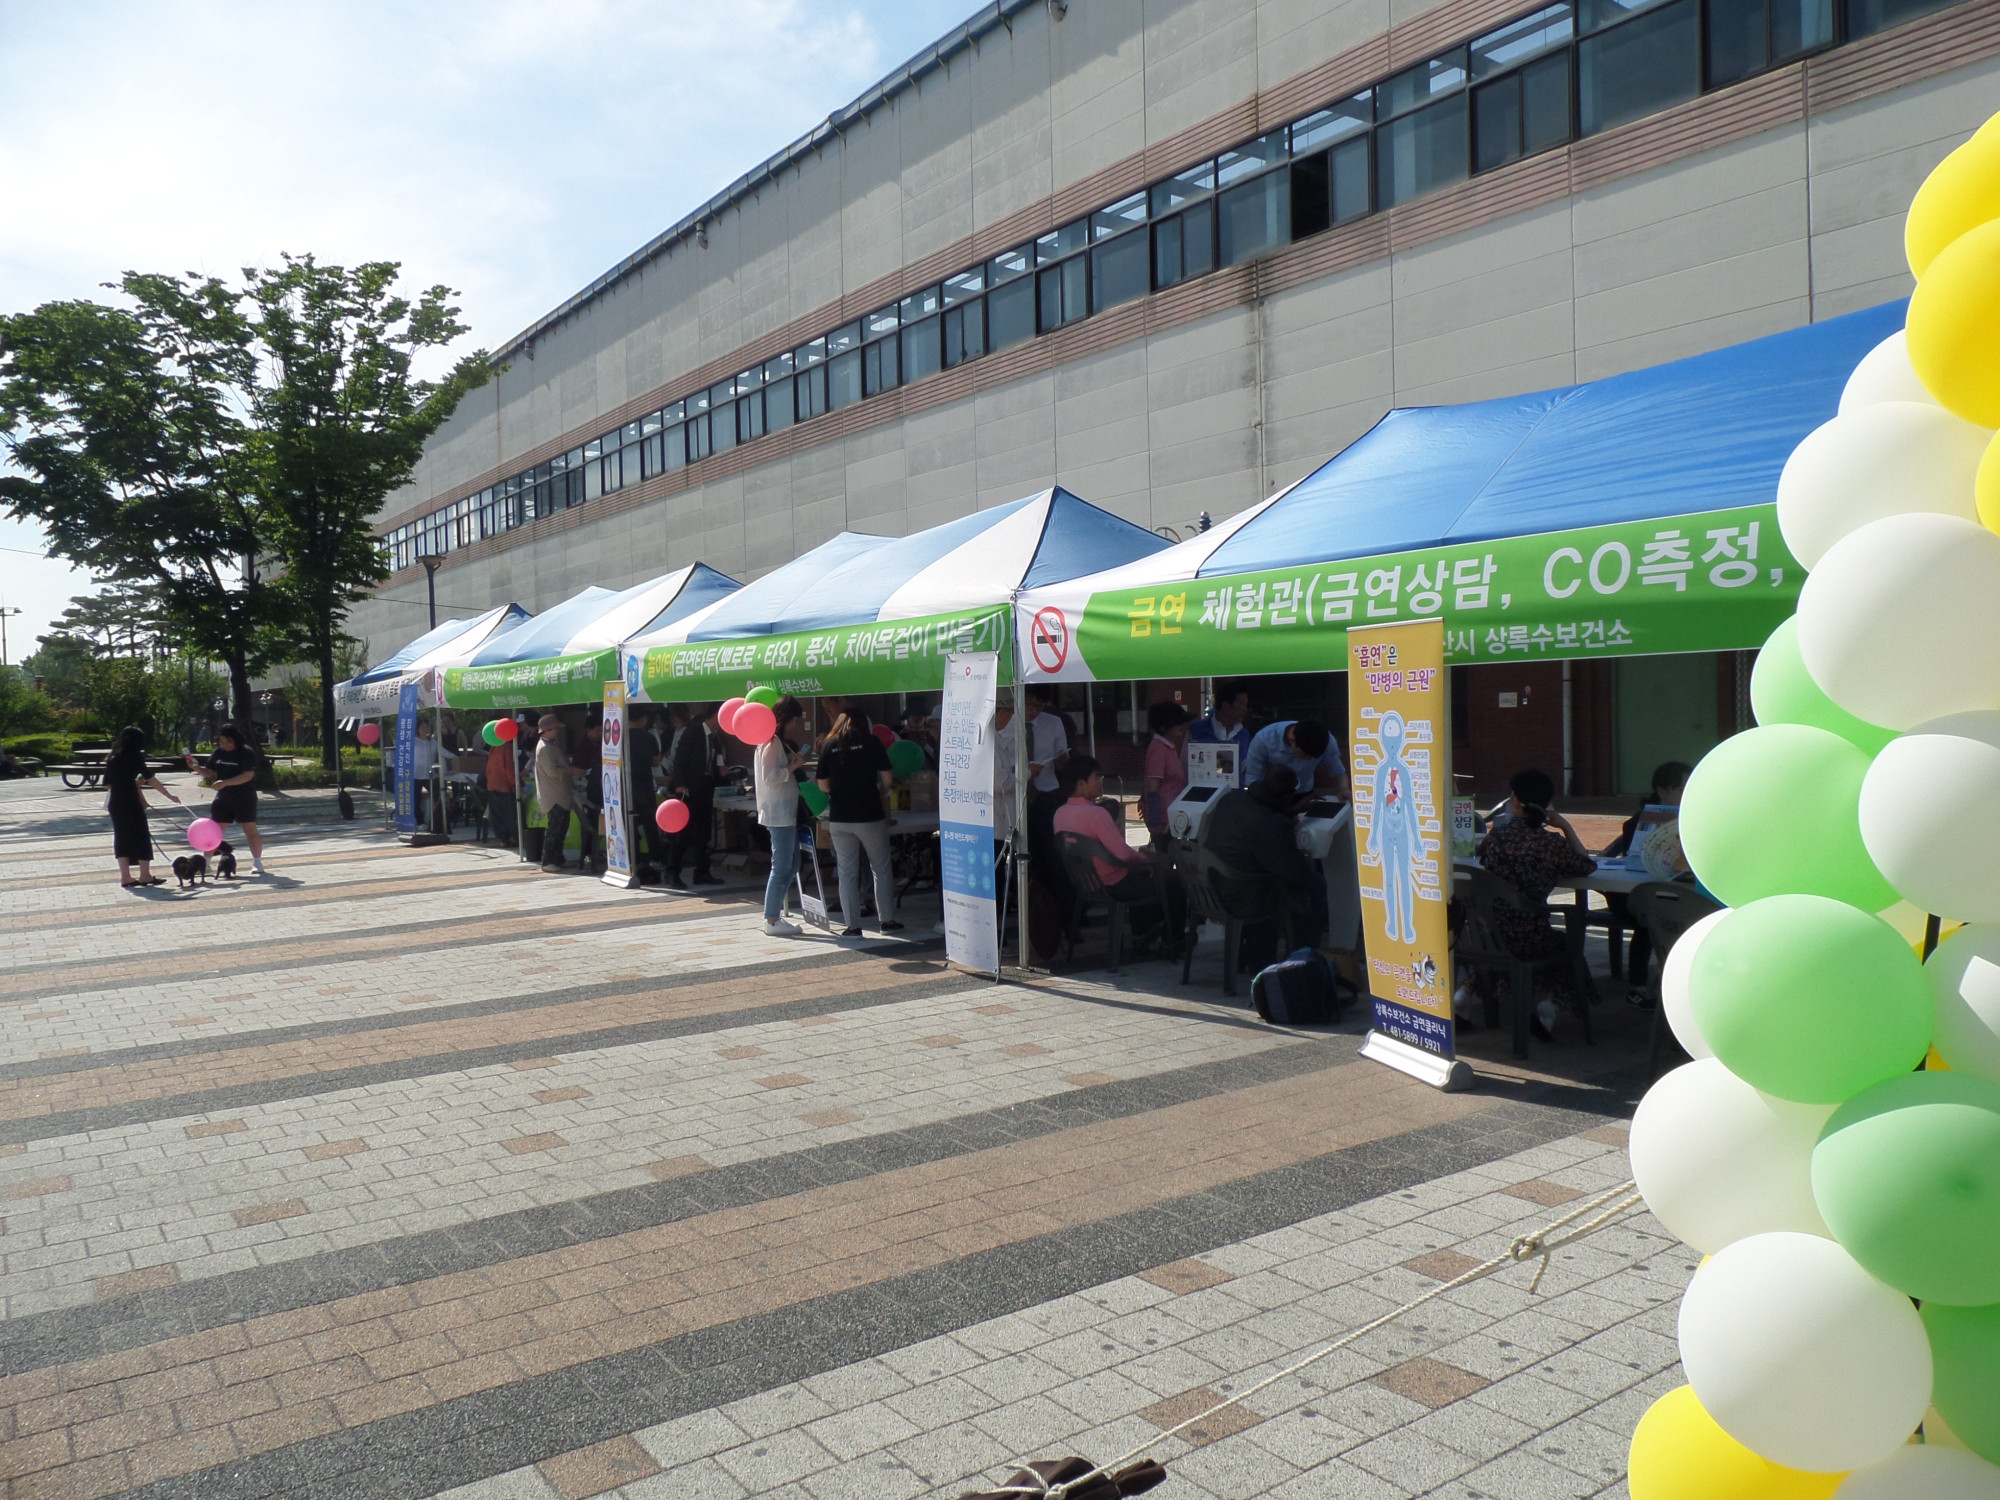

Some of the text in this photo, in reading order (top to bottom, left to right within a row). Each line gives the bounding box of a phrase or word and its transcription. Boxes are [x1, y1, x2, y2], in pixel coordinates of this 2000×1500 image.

[1127, 520, 1784, 638] 금연 체험관(금연상담, CO측정,
[805, 634, 838, 668] 풍선,
[844, 622, 931, 663] 치아목걸이
[936, 610, 1006, 655] 만들기)
[1484, 618, 1633, 656] 상록수보건소
[943, 753, 971, 770] 두뇌건강
[943, 770, 956, 786] 지금
[1454, 802, 1472, 815] 금연
[1454, 815, 1472, 829] 상담
[1375, 1002, 1446, 1039] 상록수보건소 금연클리닉
[1424, 1037, 1441, 1053] 5921
